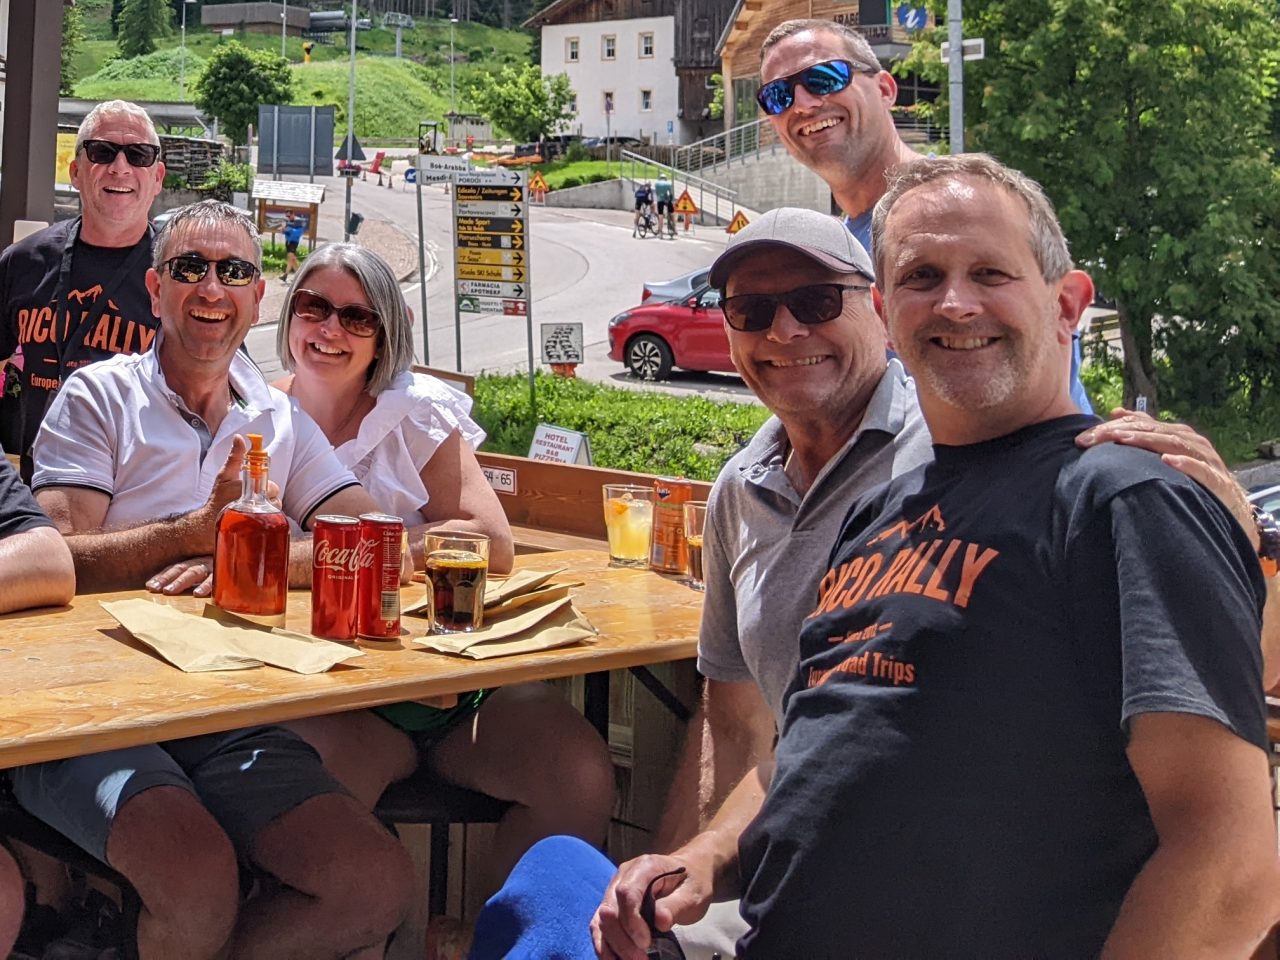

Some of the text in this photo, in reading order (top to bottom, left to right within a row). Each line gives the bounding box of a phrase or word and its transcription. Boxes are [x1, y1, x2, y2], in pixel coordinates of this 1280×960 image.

[470, 282, 501, 290] FARMACIA
[81, 311, 156, 355] ALLY
[31, 373, 59, 391] Europe
[535, 439, 575, 453] RESTAURANT
[544, 432, 569, 444] HOTEL
[500, 473, 512, 486] 65
[866, 539, 1000, 609] RALLY
[837, 651, 916, 686] oad Trips
